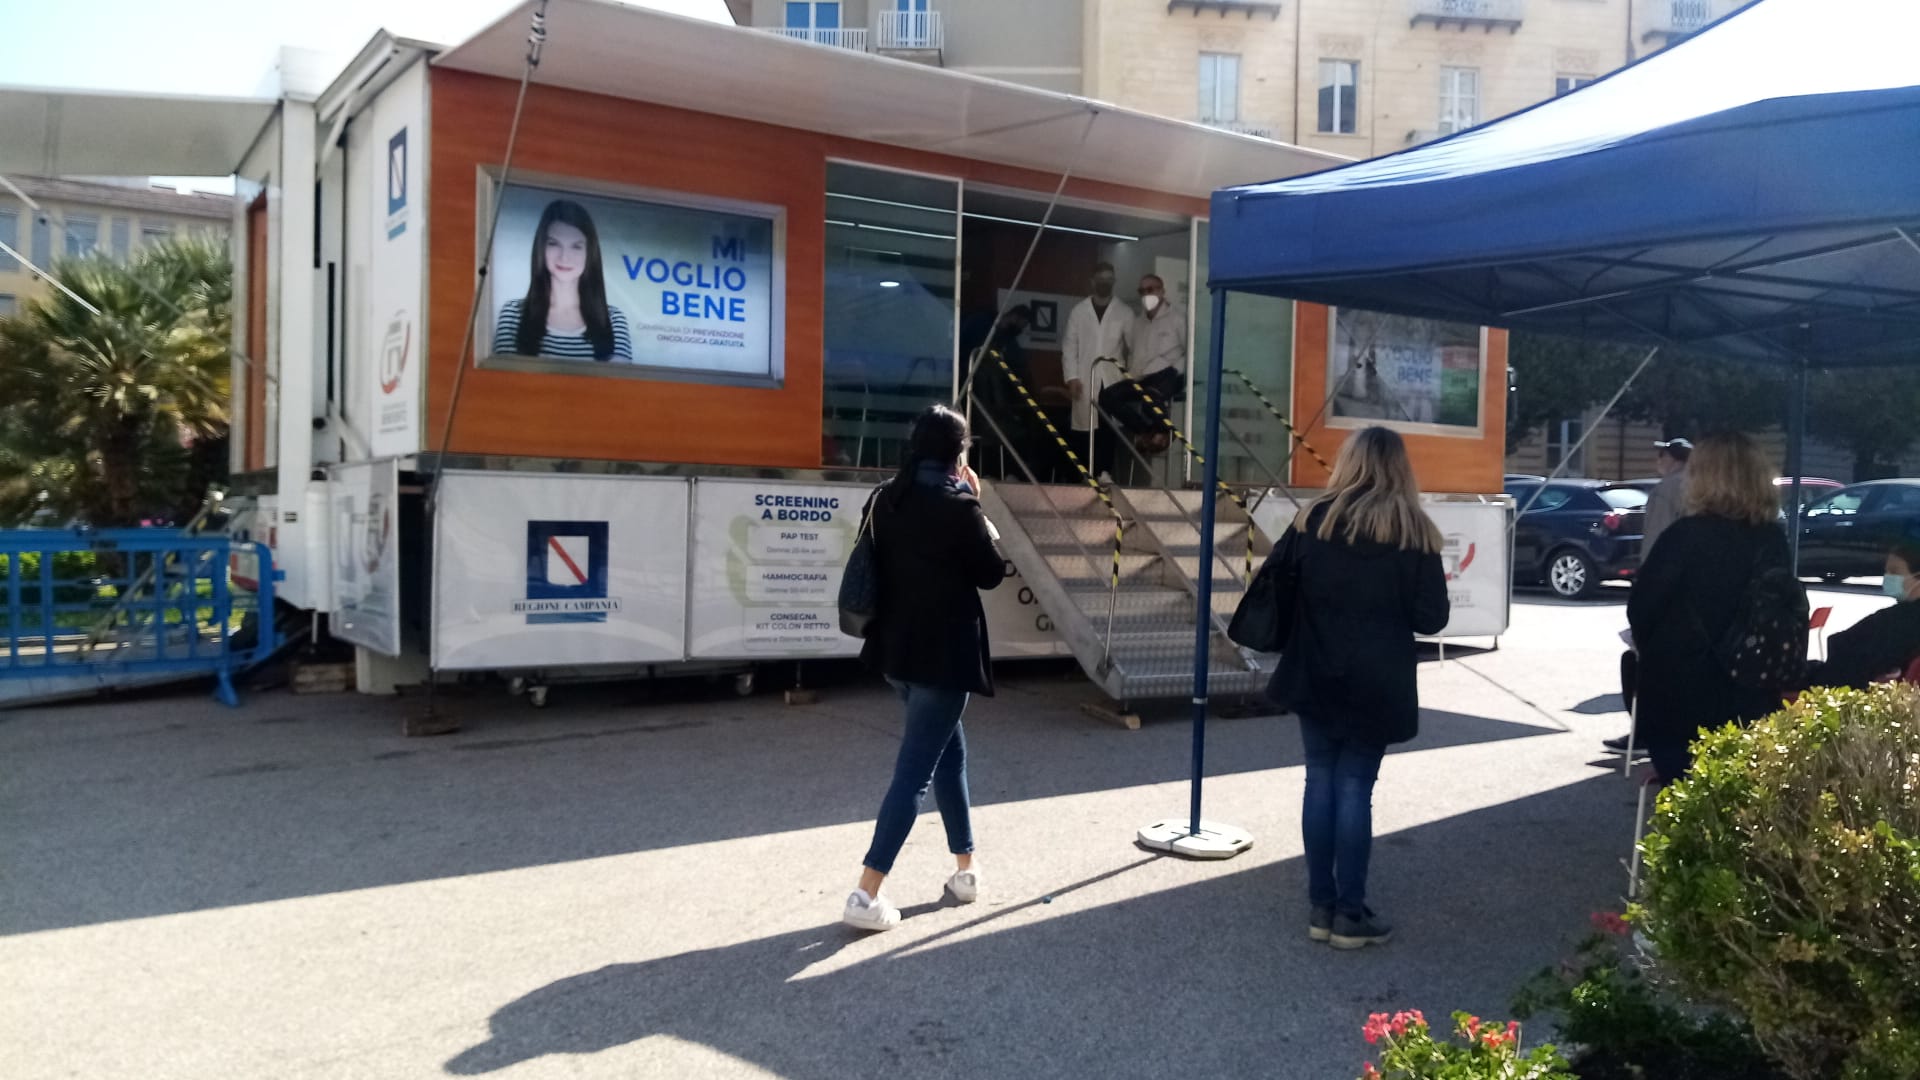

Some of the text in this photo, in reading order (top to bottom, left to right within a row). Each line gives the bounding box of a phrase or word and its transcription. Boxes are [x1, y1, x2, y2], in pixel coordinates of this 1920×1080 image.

[712, 235, 745, 262] MI
[622, 254, 746, 292] VOGLIO
[662, 290, 746, 322] BENE
[692, 328, 745, 339] PREVENZIONE
[656, 334, 745, 348] ONCOLOGICA GRATUITA
[755, 494, 839, 509] SCREENING
[761, 509, 832, 522] A BORDO
[780, 532, 819, 541] PAP TEST
[762, 573, 828, 581] MAMMOGRAFIA
[513, 600, 619, 612] REGIONE CAMPANIA
[770, 613, 818, 621] CONSEGNA
[756, 622, 831, 630] KIT COLON RETTO
